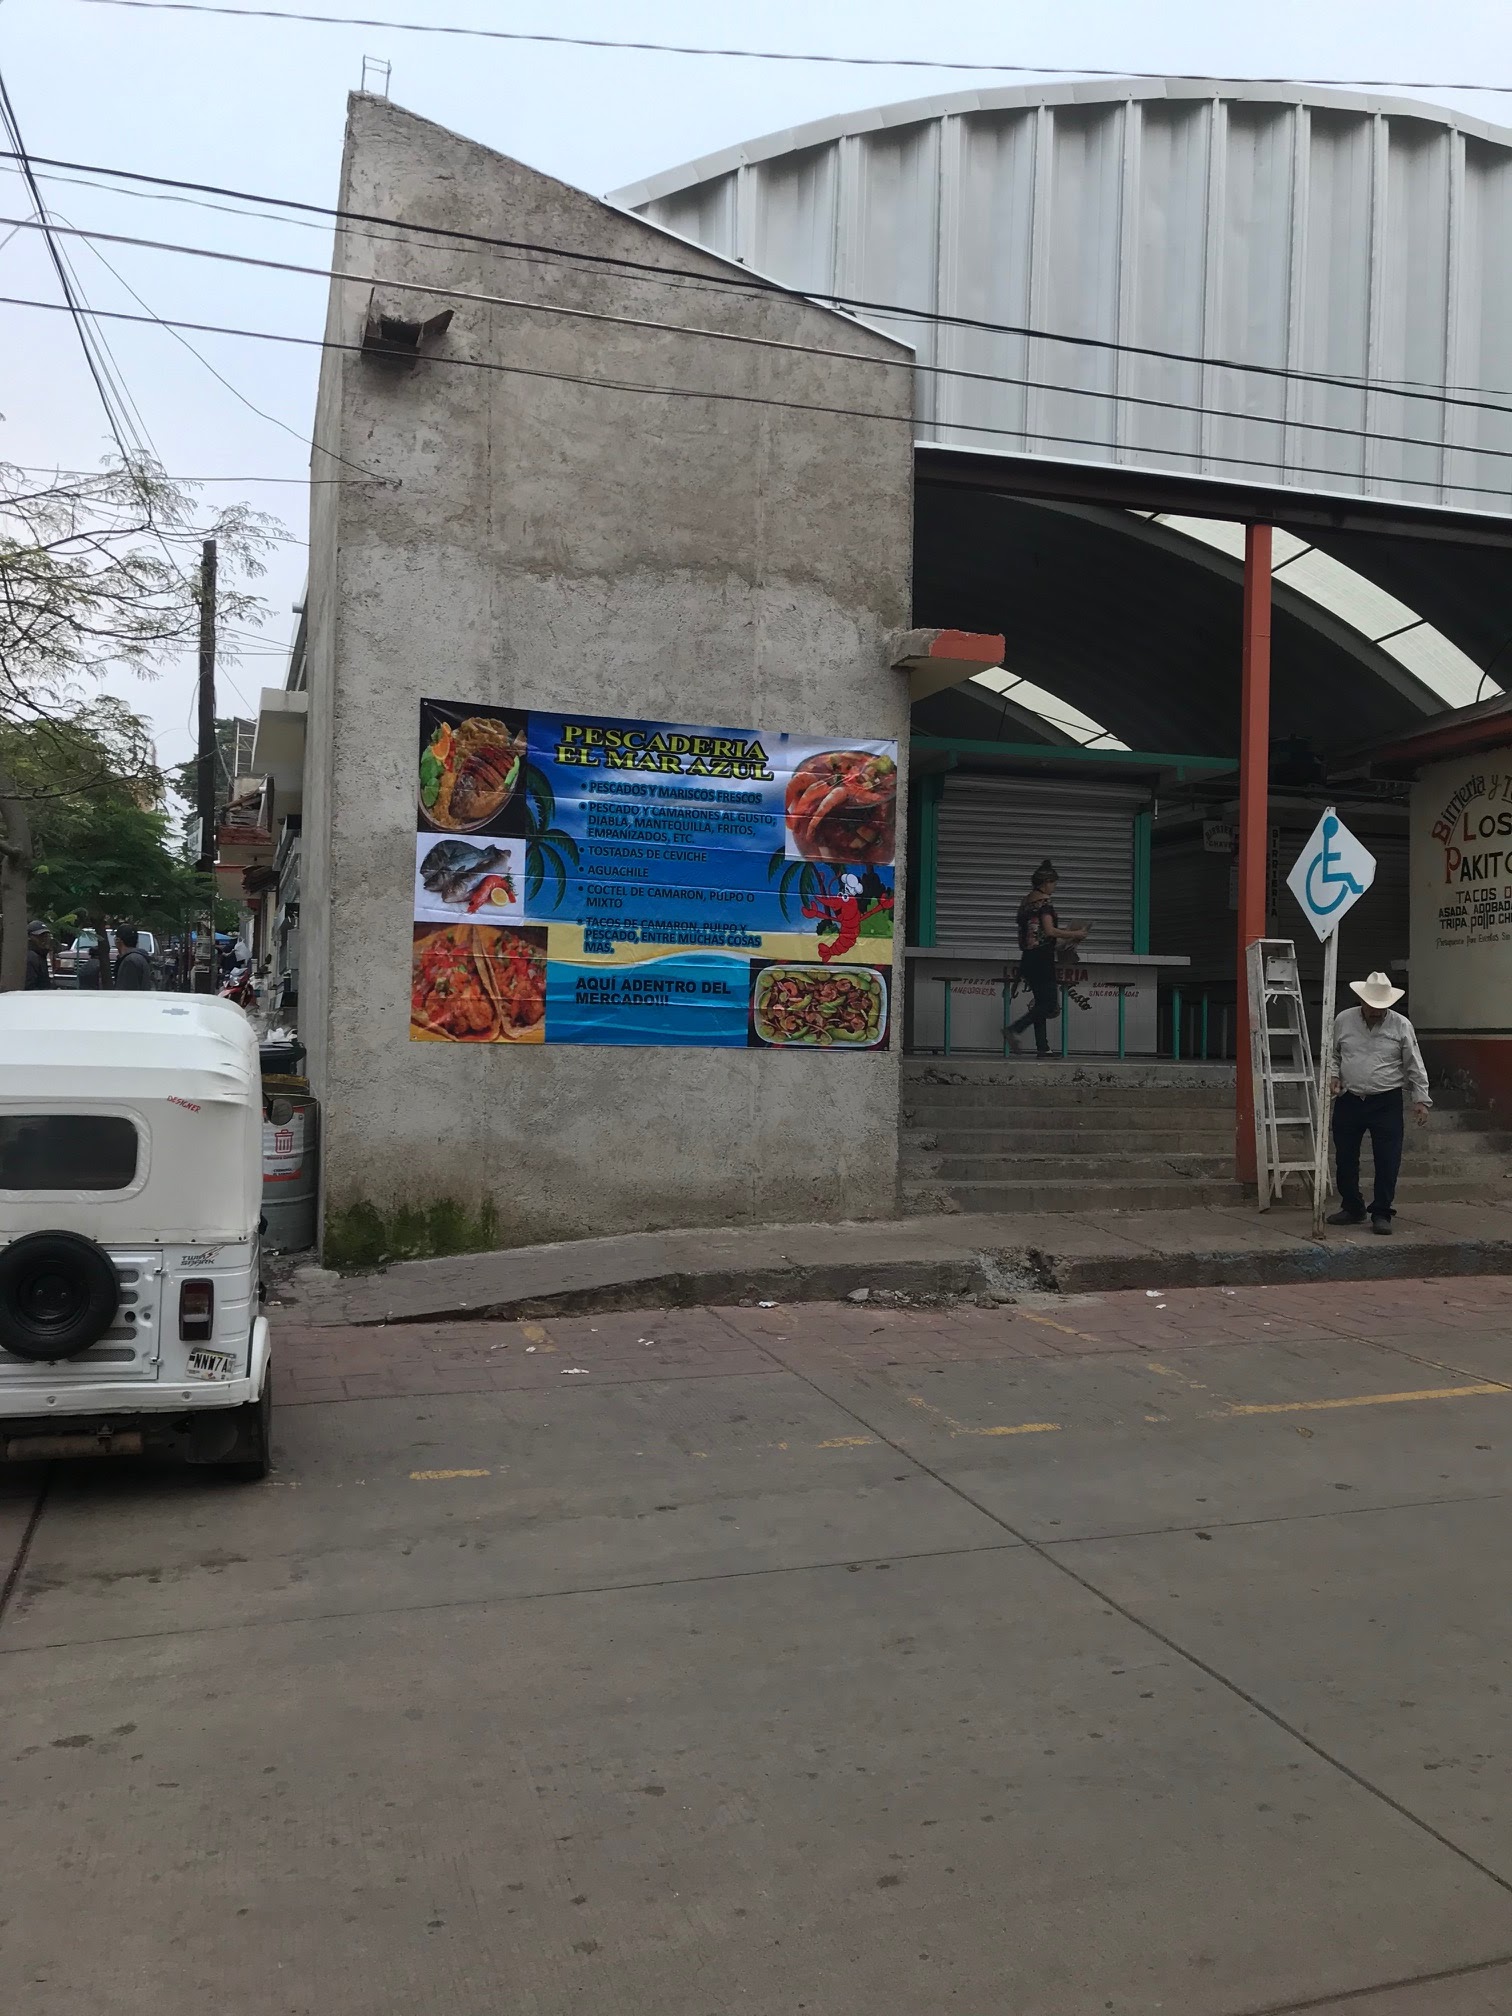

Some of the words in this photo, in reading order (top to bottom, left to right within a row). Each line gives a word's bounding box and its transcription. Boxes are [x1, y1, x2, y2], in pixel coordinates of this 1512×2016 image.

[563, 725, 767, 760] PESCADERIA
[556, 746, 600, 765] EL
[606, 750, 682, 773] MAR
[686, 757, 774, 780] AZUL
[589, 782, 647, 796] PESCADOS
[648, 786, 656, 796] Y
[658, 787, 715, 801] MARISCOS
[717, 791, 762, 804] FRESCOS
[1488, 774, 1502, 800] y
[589, 803, 639, 815] PESCADO
[642, 805, 650, 815] Y
[652, 807, 720, 821] CAMARONES
[722, 812, 736, 822] AL
[588, 815, 631, 829] DIABLA,
[634, 818, 714, 834] MANTEQUILLA,
[717, 824, 756, 837] FRITOS,
[1463, 812, 1512, 842] LOS
[588, 828, 670, 843] EMPANIZADOS,
[673, 833, 695, 844] ETC.
[588, 846, 644, 858] TOSTADAS
[646, 850, 660, 859] DE
[663, 851, 707, 862] CEVICHE
[587, 865, 649, 878] AGUACHILE
[587, 884, 627, 896] COCTEL
[630, 887, 644, 897] DE
[647, 887, 706, 902] CAMARON,
[710, 891, 744, 902] PULPO
[746, 893, 755, 903] O
[587, 897, 623, 908] MIXTO
[1456, 887, 1497, 904] TACOS
[586, 916, 621, 928] TACOS
[624, 919, 638, 929] DE
[641, 919, 700, 933] CAMARON,
[703, 922, 738, 933] PULPO
[740, 924, 748, 933] Y
[584, 941, 615, 954] MAS.
[585, 929, 638, 943] PESCADO,
[641, 932, 675, 944] ENTRE
[678, 933, 725, 946] MUCHAS
[727, 935, 762, 947] COSAS
[575, 976, 616, 991] AQUÍ
[621, 978, 697, 993] ADENTRO
[701, 981, 731, 995] DEL
[575, 992, 669, 1007] MERCADO!!!
[167, 1095, 202, 1114] DESIGNER
